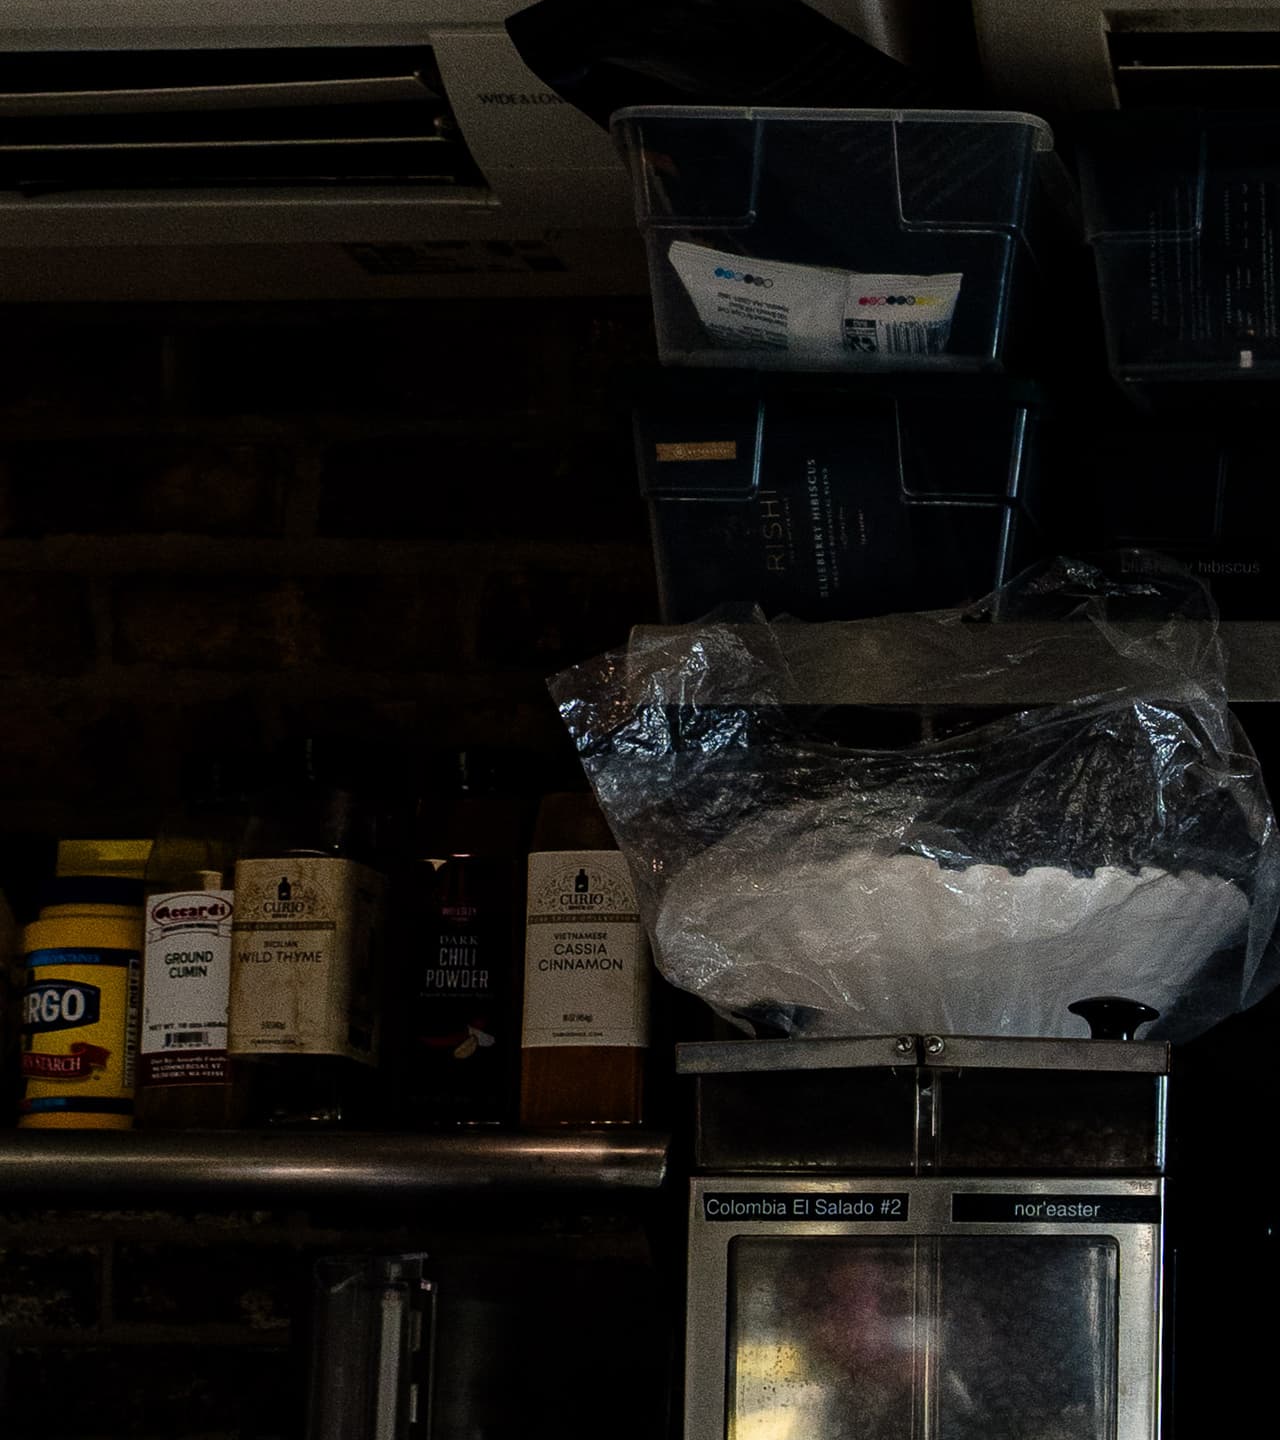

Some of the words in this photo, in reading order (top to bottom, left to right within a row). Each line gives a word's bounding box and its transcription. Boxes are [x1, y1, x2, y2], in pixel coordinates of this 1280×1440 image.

[807, 459, 821, 520] HIBISCUS
[760, 489, 786, 572] RISHI
[1198, 560, 1261, 575] hibiscus
[560, 893, 604, 905] CURIO
[263, 902, 305, 913] CURIO
[554, 932, 608, 940] VIETNAMESE
[554, 943, 608, 955] CASSIA
[165, 951, 213, 964] GROUND
[238, 951, 271, 964] WILD
[277, 951, 322, 963] THYME
[439, 947, 477, 967] CHILI
[538, 959, 624, 971] CINNAMON
[169, 966, 207, 978] CUMIN
[425, 969, 489, 988] POWDER
[706, 1199, 787, 1217] Colombia
[792, 1199, 810, 1216] El
[814, 1199, 874, 1216] Salado
[879, 1199, 901, 1216] #2
[1013, 1201, 1101, 1217] nor'easter
